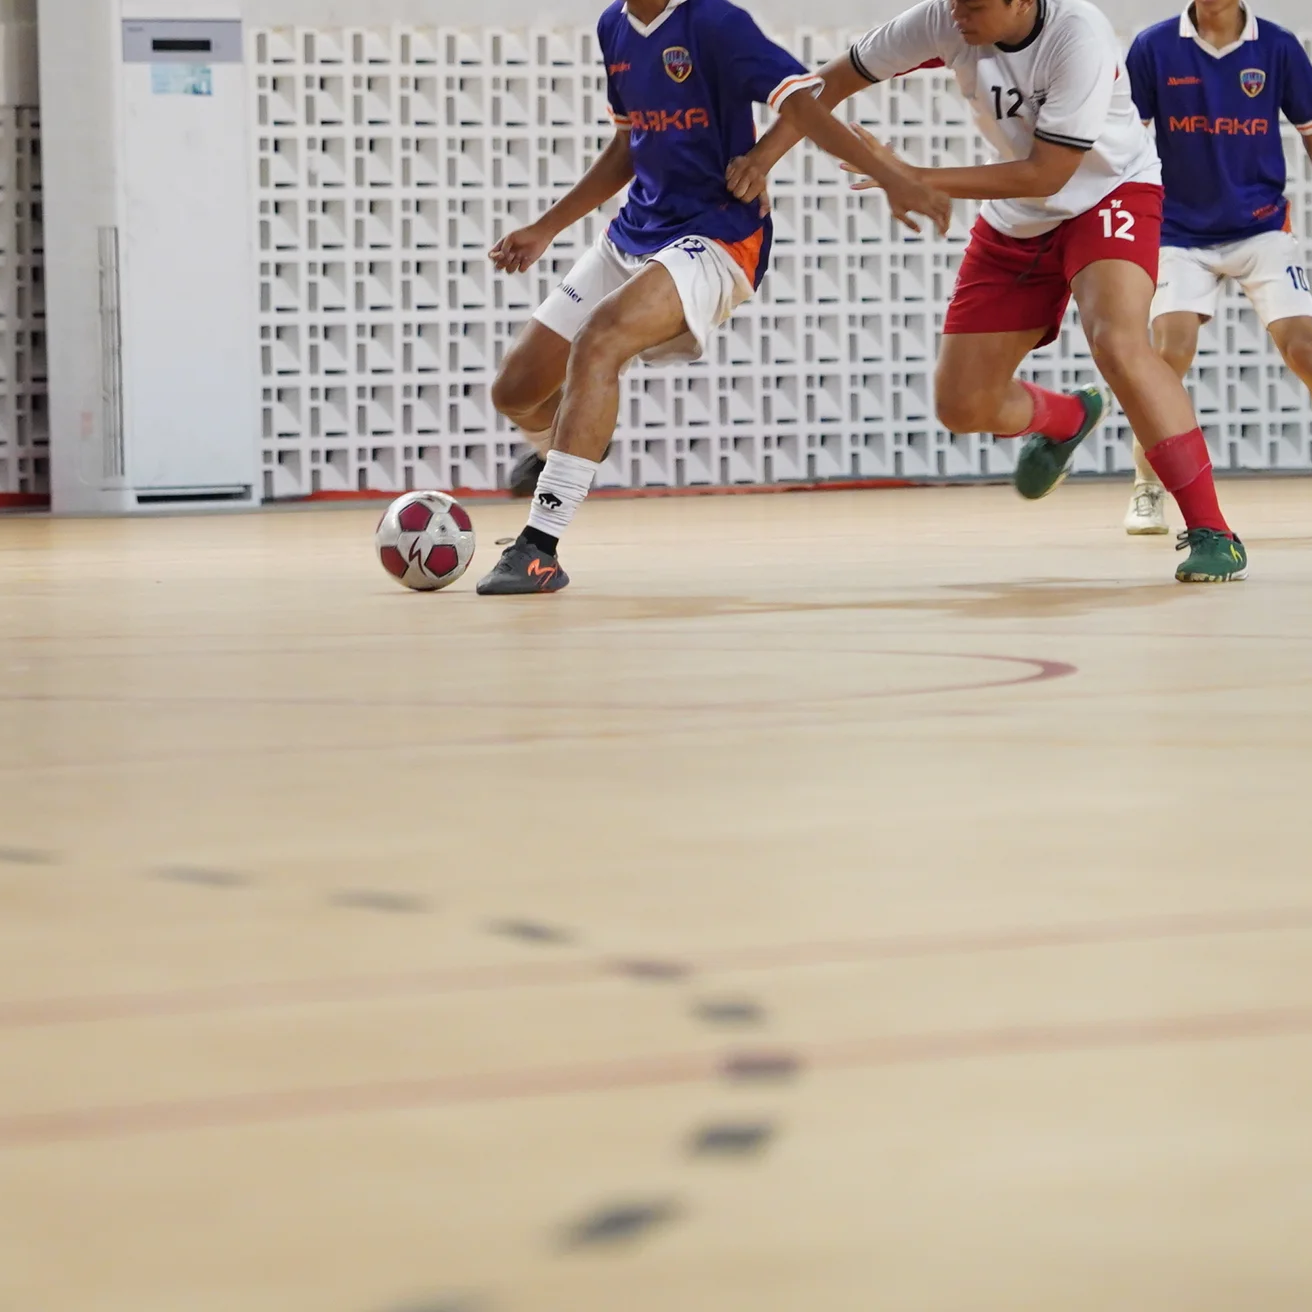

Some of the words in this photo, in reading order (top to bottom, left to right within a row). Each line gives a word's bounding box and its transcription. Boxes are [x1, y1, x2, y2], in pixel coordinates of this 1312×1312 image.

[990, 84, 1024, 120] 12
[1098, 208, 1135, 242] 12
[1286, 265, 1309, 291] 10
